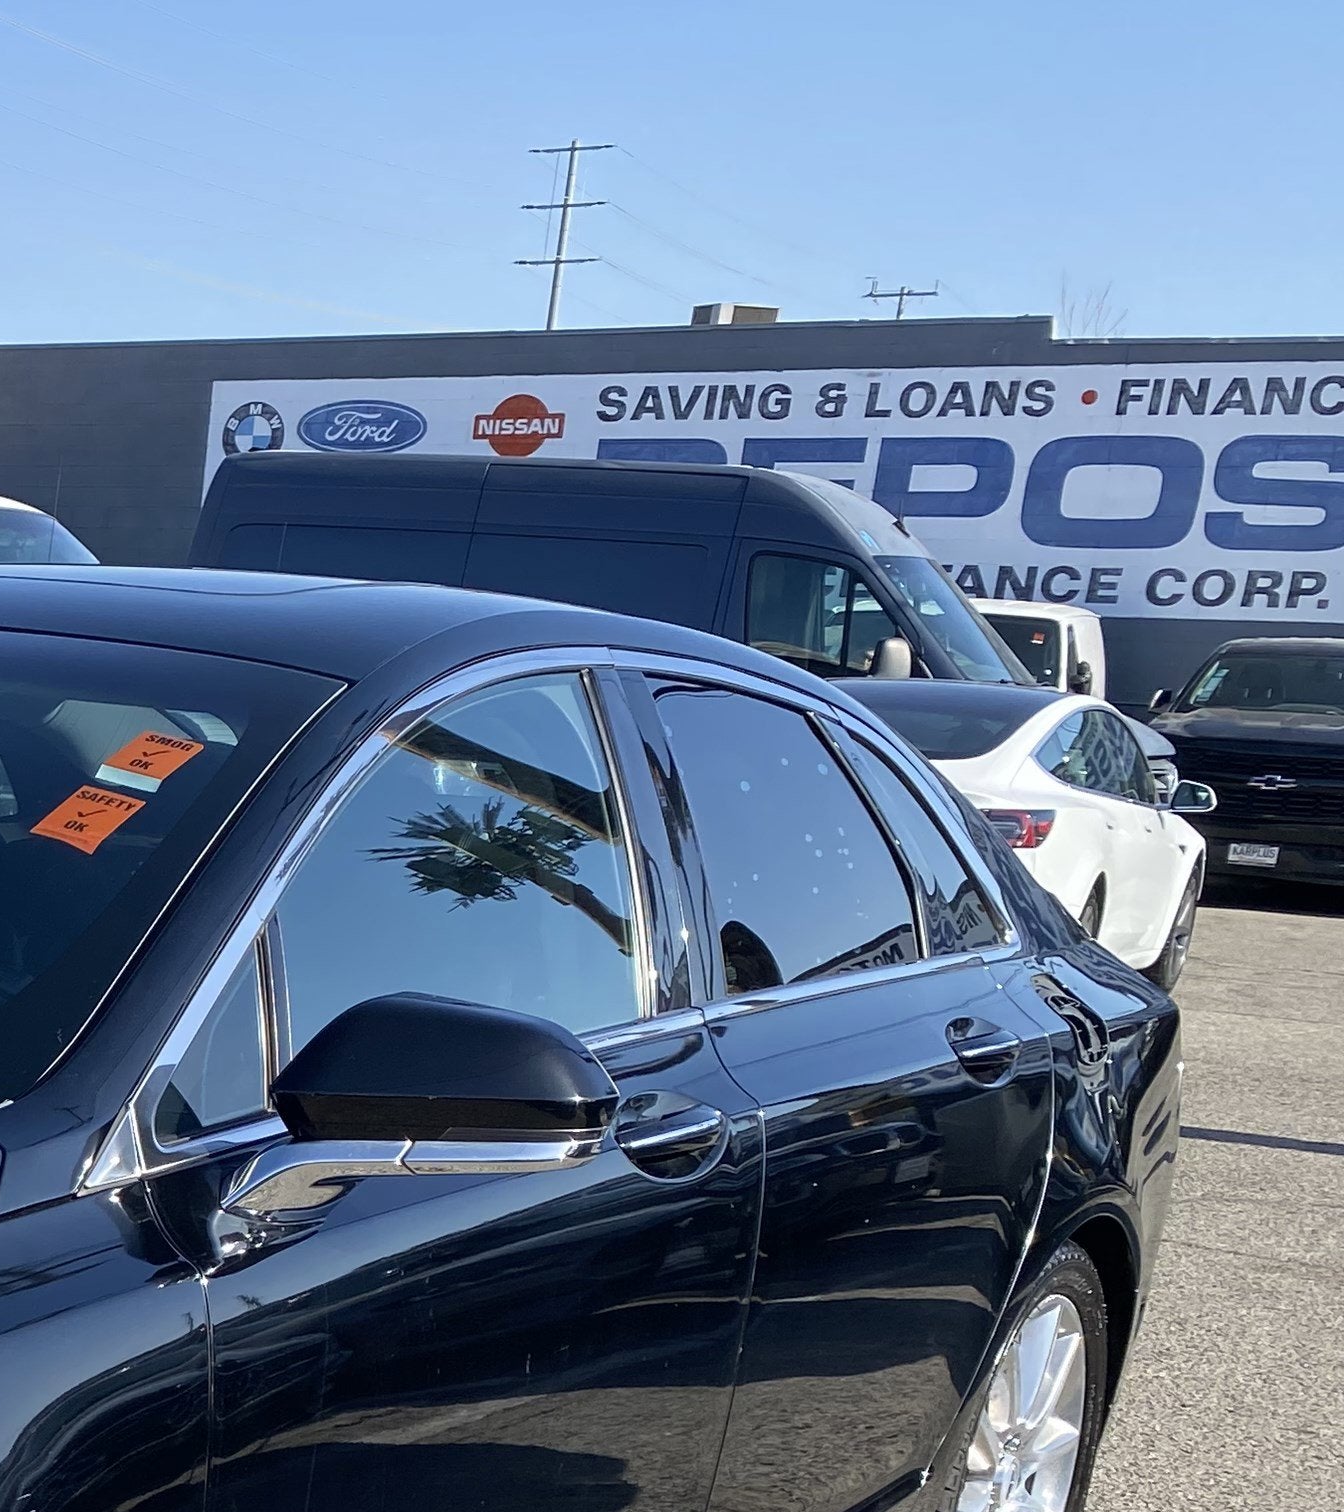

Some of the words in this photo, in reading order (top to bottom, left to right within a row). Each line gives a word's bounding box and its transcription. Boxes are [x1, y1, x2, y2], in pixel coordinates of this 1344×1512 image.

[596, 384, 792, 422] SAVING
[815, 383, 848, 416] &
[864, 379, 1056, 419] LOANS
[325, 411, 398, 444] Ford
[478, 417, 559, 436] NISSAN
[1146, 567, 1331, 609] CORP.
[145, 734, 193, 752] SMOG
[129, 758, 154, 770] OK
[75, 789, 136, 812] SAFETY
[64, 819, 89, 833] OK
[1232, 846, 1276, 858] KARPLUS
